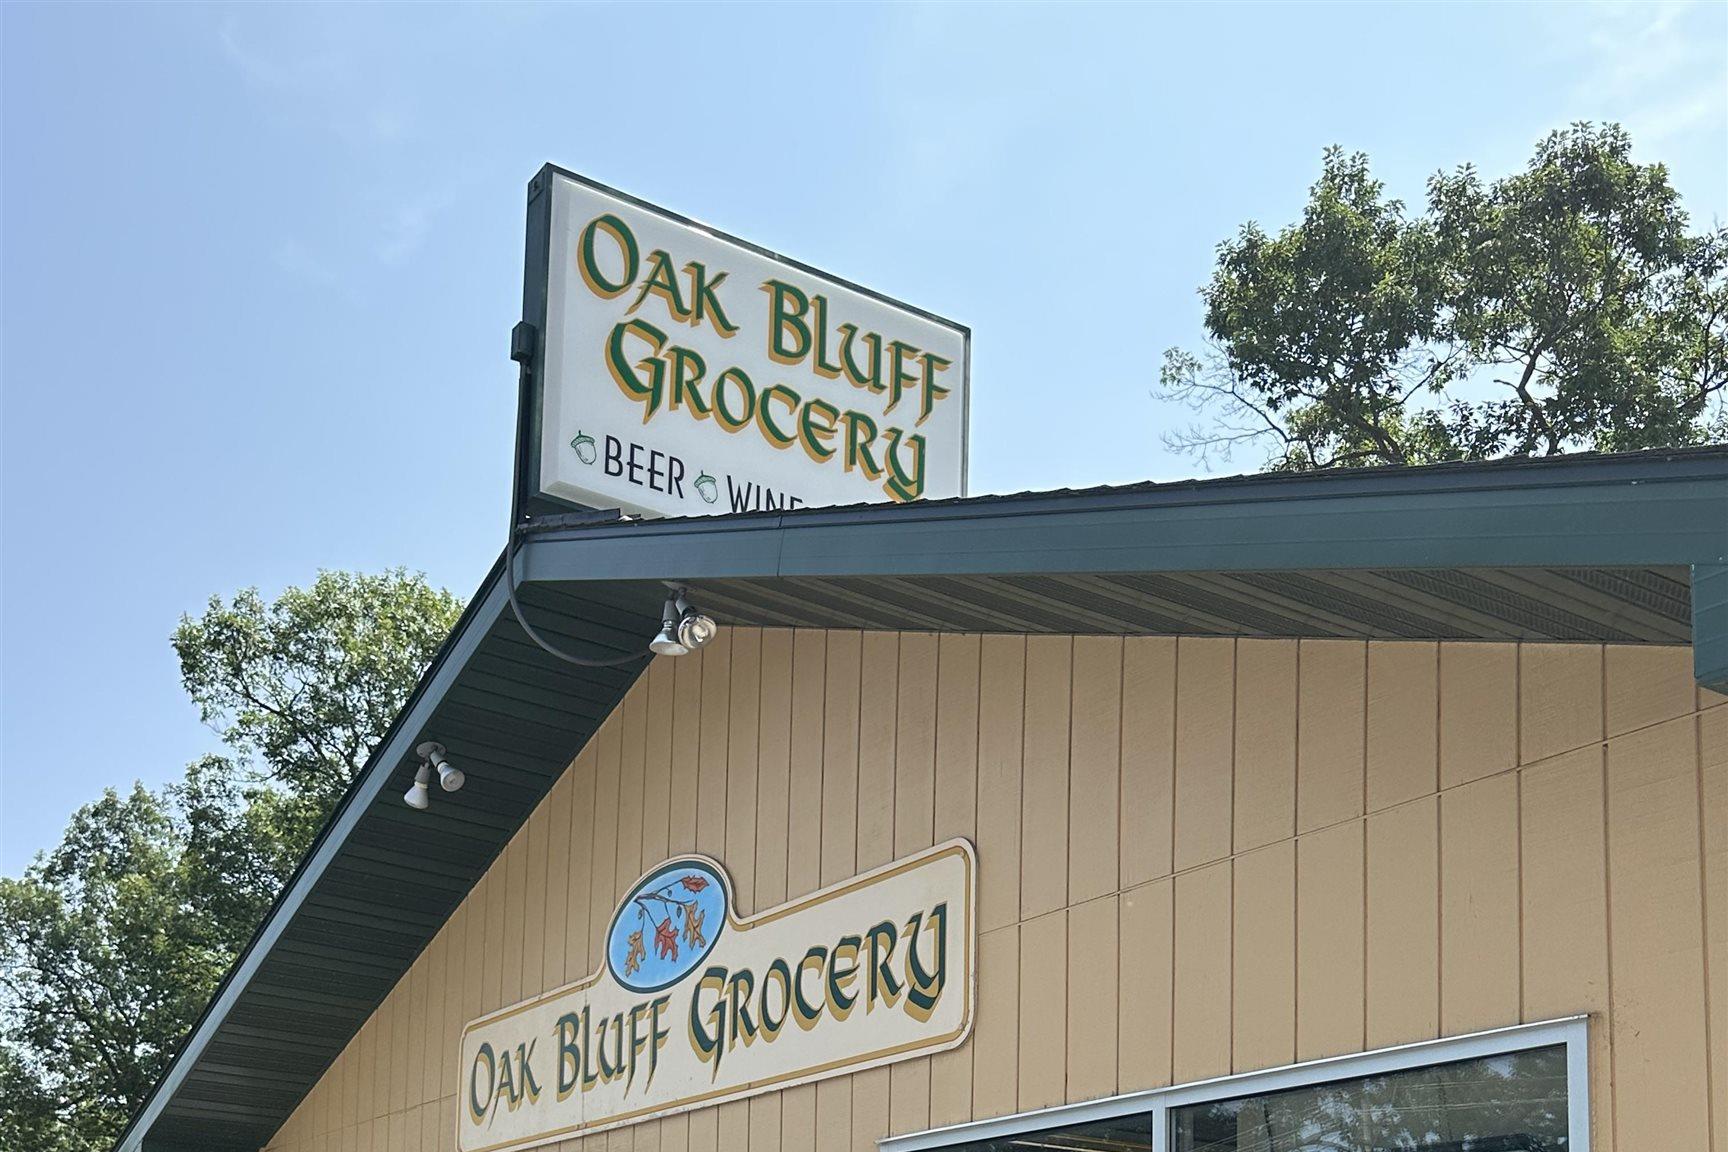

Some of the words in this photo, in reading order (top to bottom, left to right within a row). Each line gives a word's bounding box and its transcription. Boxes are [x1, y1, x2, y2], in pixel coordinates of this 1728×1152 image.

[577, 213, 739, 339] OAK
[758, 279, 953, 427] BLUFF
[605, 318, 926, 502] GROCERY
[604, 434, 684, 499] BEER
[469, 1035, 542, 1128] OAK
[552, 993, 671, 1098] BLUFF
[687, 902, 947, 1083] GROCERY
